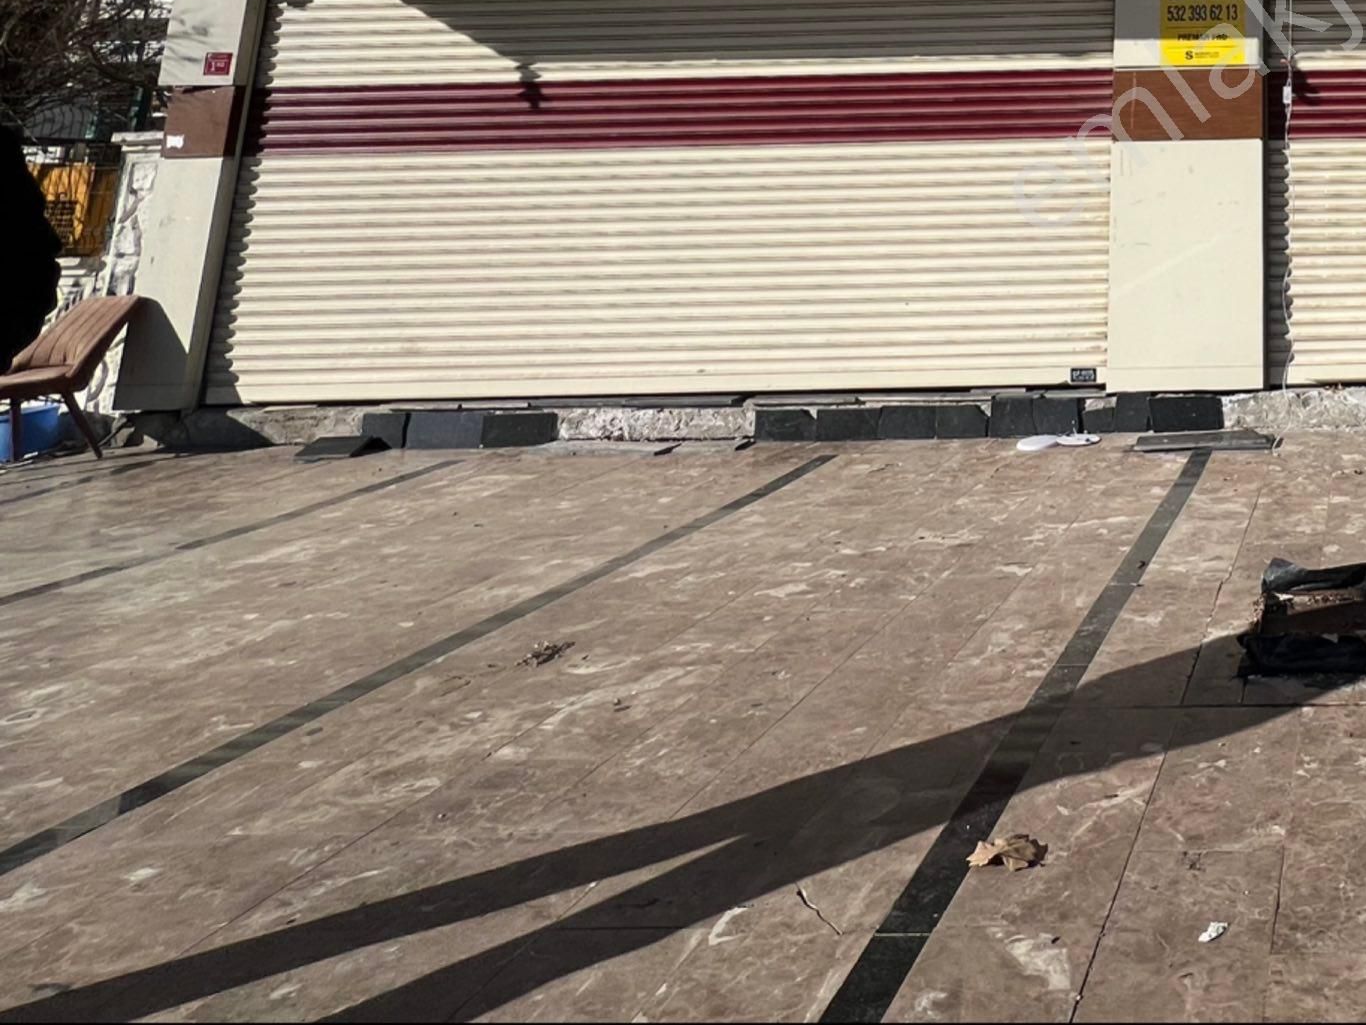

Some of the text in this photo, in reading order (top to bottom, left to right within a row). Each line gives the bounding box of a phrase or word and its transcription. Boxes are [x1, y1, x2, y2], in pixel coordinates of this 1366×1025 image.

[1167, 4, 1238, 21] 532 393 62 13
